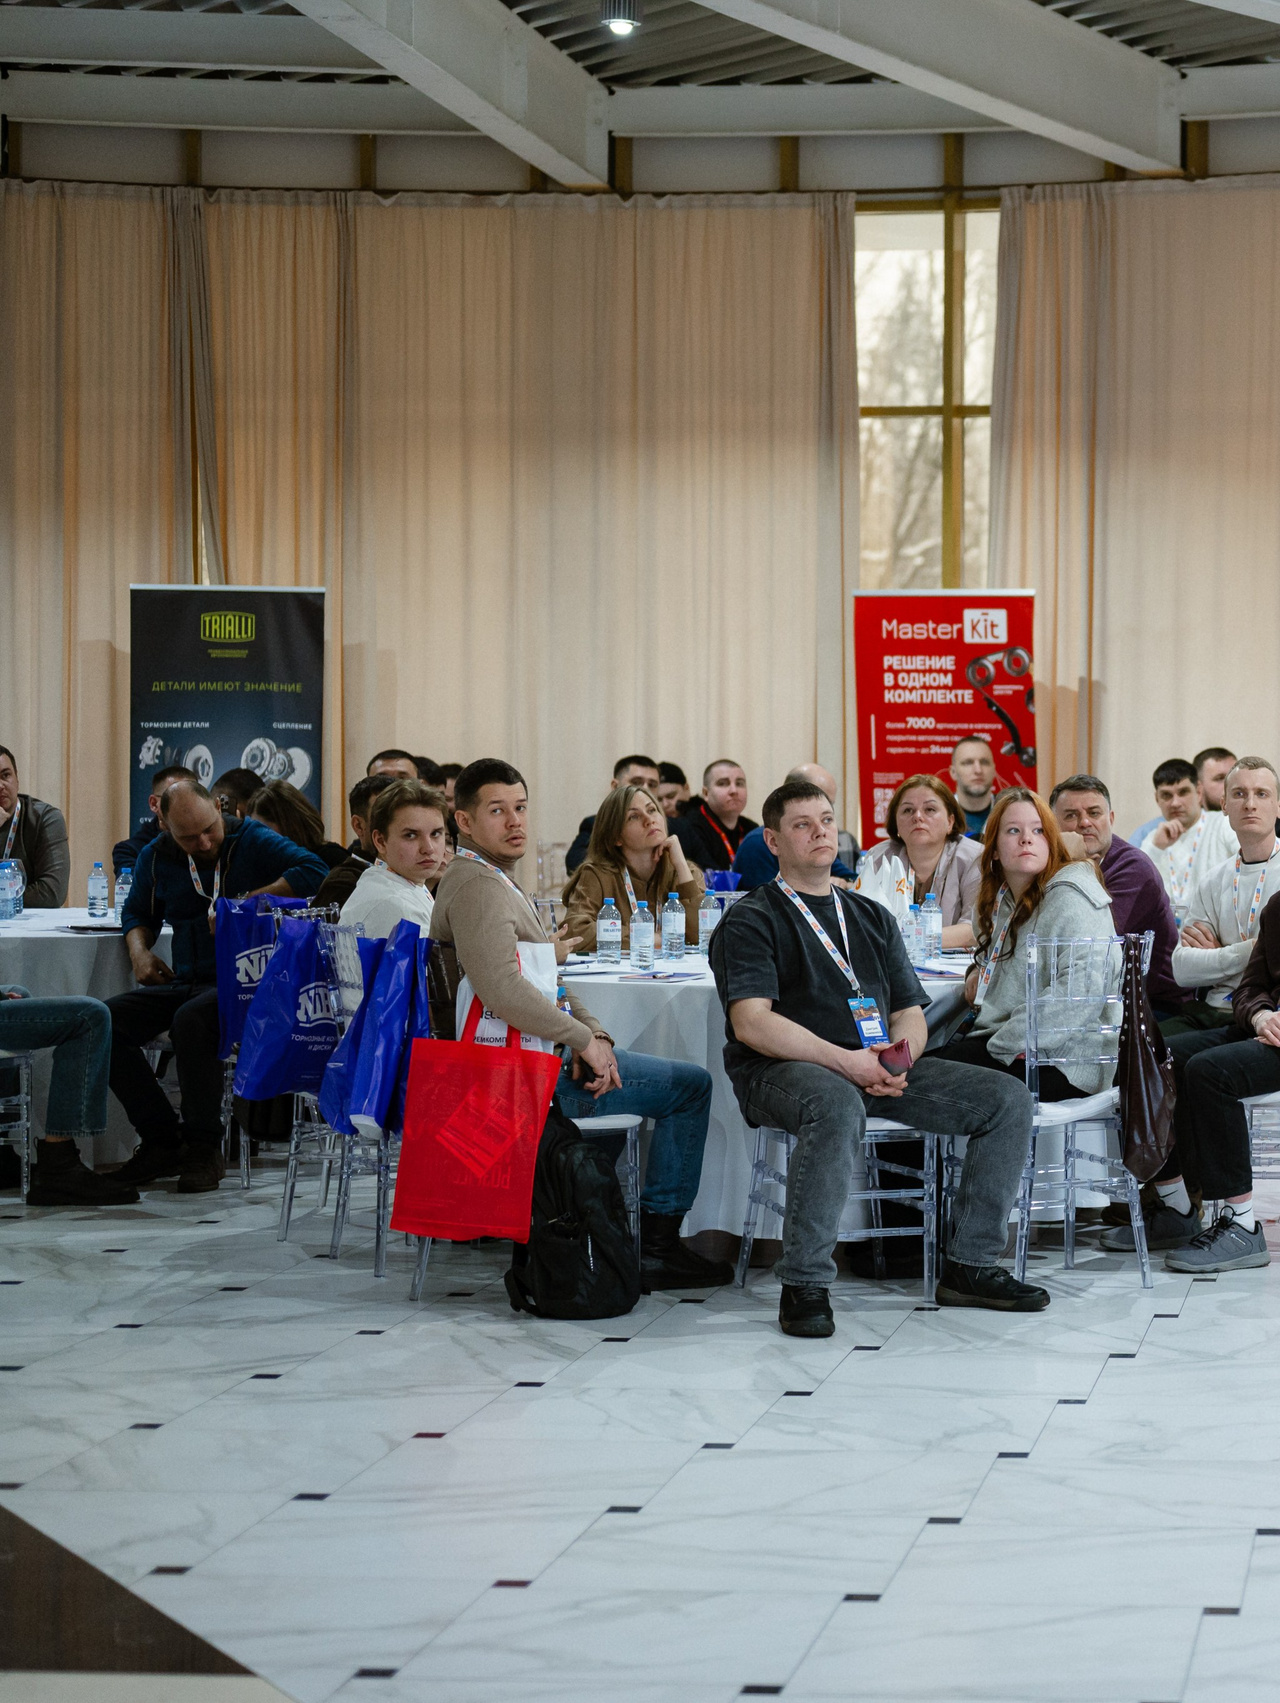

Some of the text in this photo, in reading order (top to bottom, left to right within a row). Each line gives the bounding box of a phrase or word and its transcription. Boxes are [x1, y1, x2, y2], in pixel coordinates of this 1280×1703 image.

[203, 613, 252, 639] TRIALLI
[881, 612, 1000, 640] Master Kit
[883, 655, 956, 670] РЕШЕНИЕ
[152, 681, 303, 693] ДЕТАЛИ ИМЕЮТ ЗНАЧЕНИЕ
[884, 672, 953, 688] В ОДНОМ
[884, 689, 974, 704] КОМПЛЕКТЕ
[140, 721, 210, 730] ТОРМОЗНЫЕ ДЕТАЛИ
[272, 722, 313, 731] СЦЕПЛЕНИЕ
[906, 717, 936, 729] 7000
[235, 947, 273, 983] Ni
[296, 987, 335, 1022] NiB
